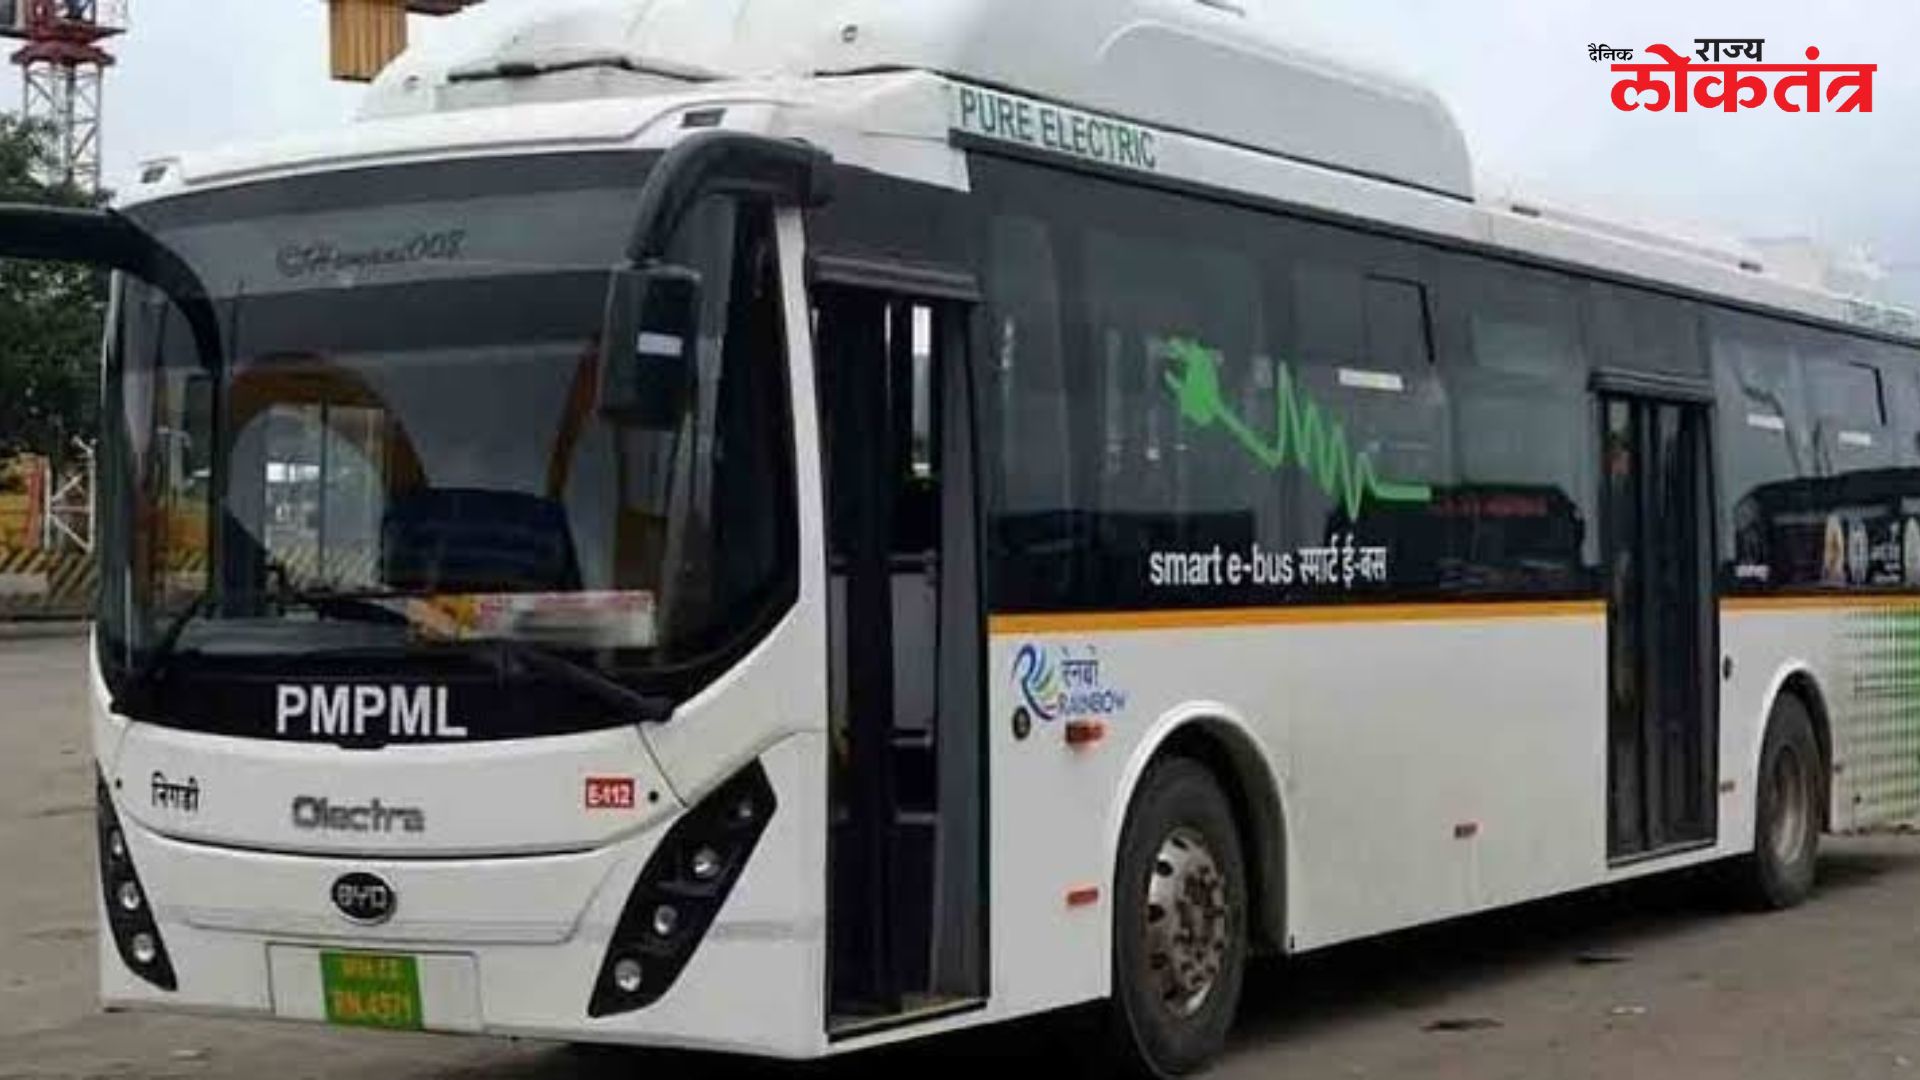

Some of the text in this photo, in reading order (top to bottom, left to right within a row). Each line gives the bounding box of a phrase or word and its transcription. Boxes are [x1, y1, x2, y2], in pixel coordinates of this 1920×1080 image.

[960, 87, 1156, 168] PURE ELECTRIC
[1150, 544, 1222, 585] smart
[1226, 543, 1293, 585] e-bus
[1297, 533, 1339, 584] स्मार्ट
[276, 684, 468, 737] PMPML
[292, 795, 426, 833] Olectra
[337, 882, 388, 909] BYD
